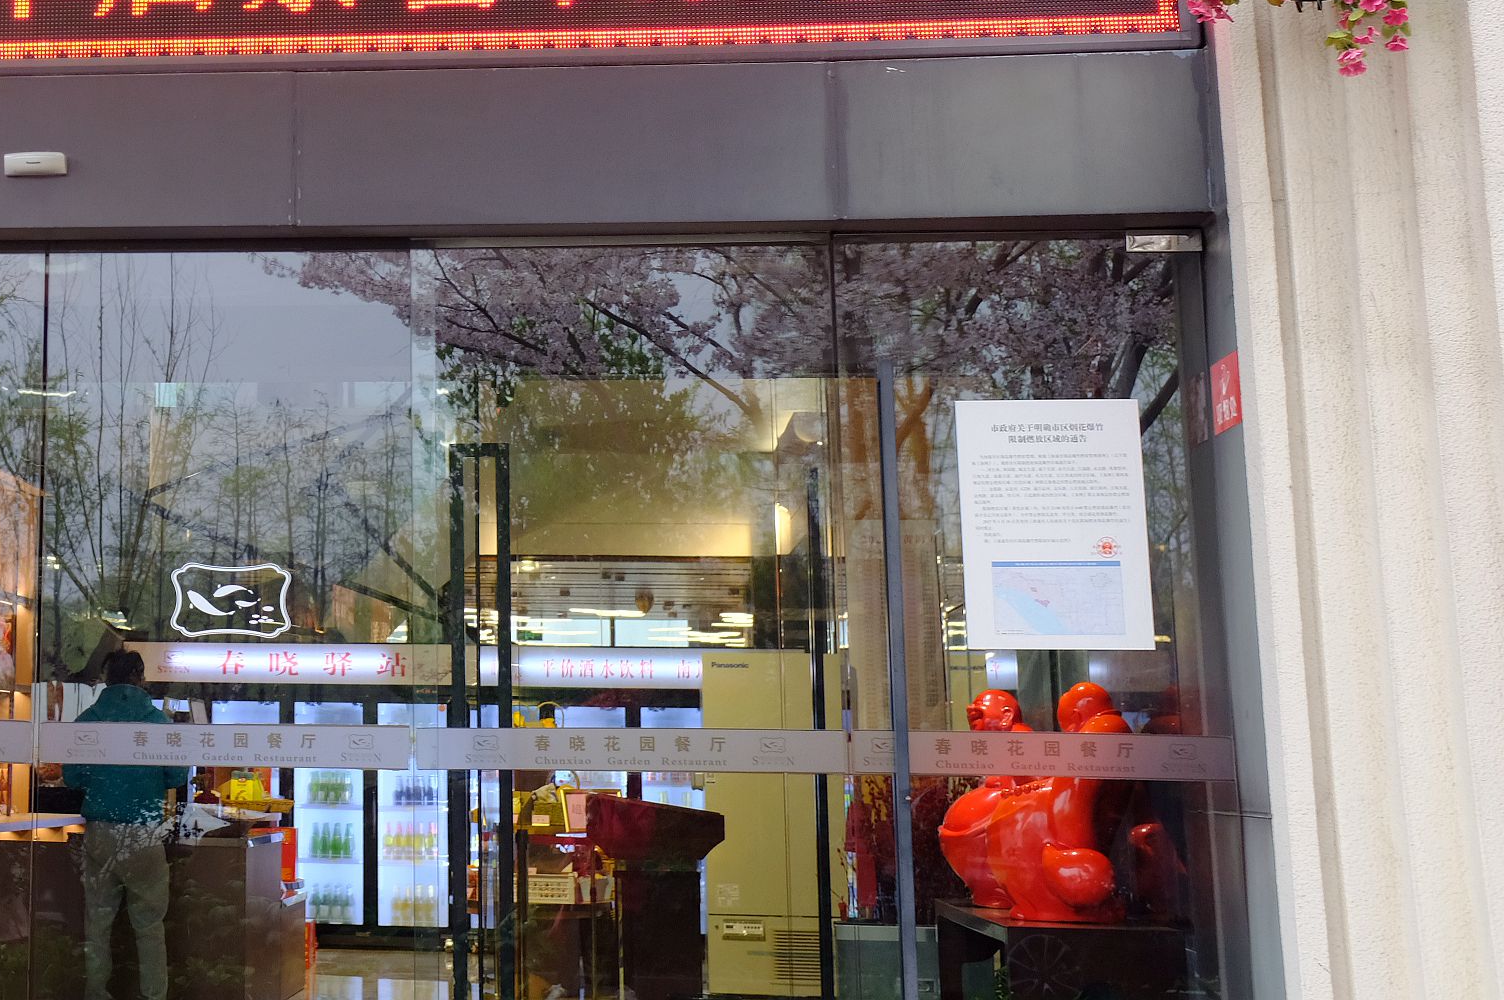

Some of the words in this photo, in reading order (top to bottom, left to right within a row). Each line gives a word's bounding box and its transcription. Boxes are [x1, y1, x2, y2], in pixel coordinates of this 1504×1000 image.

[218, 650, 408, 678] 春晓驿站
[543, 658, 655, 680] 平价酒水饮料
[711, 661, 750, 669] Panasonic
[132, 731, 317, 749] 春晓花园餐厅
[534, 735, 727, 752] 春晓花园餐厅
[934, 738, 1134, 758] 春晓花园餐厅
[132, 751, 188, 762] Chunxiao
[202, 753, 244, 762] Garden
[254, 753, 317, 764] Restaurant
[534, 755, 592, 766] Chunxiao
[607, 756, 651, 766] Garden
[661, 756, 728, 767] Restaurant
[935, 759, 995, 770] Chunxiao
[1010, 761, 1056, 771] Garden
[1067, 761, 1136, 773] Restaurant
